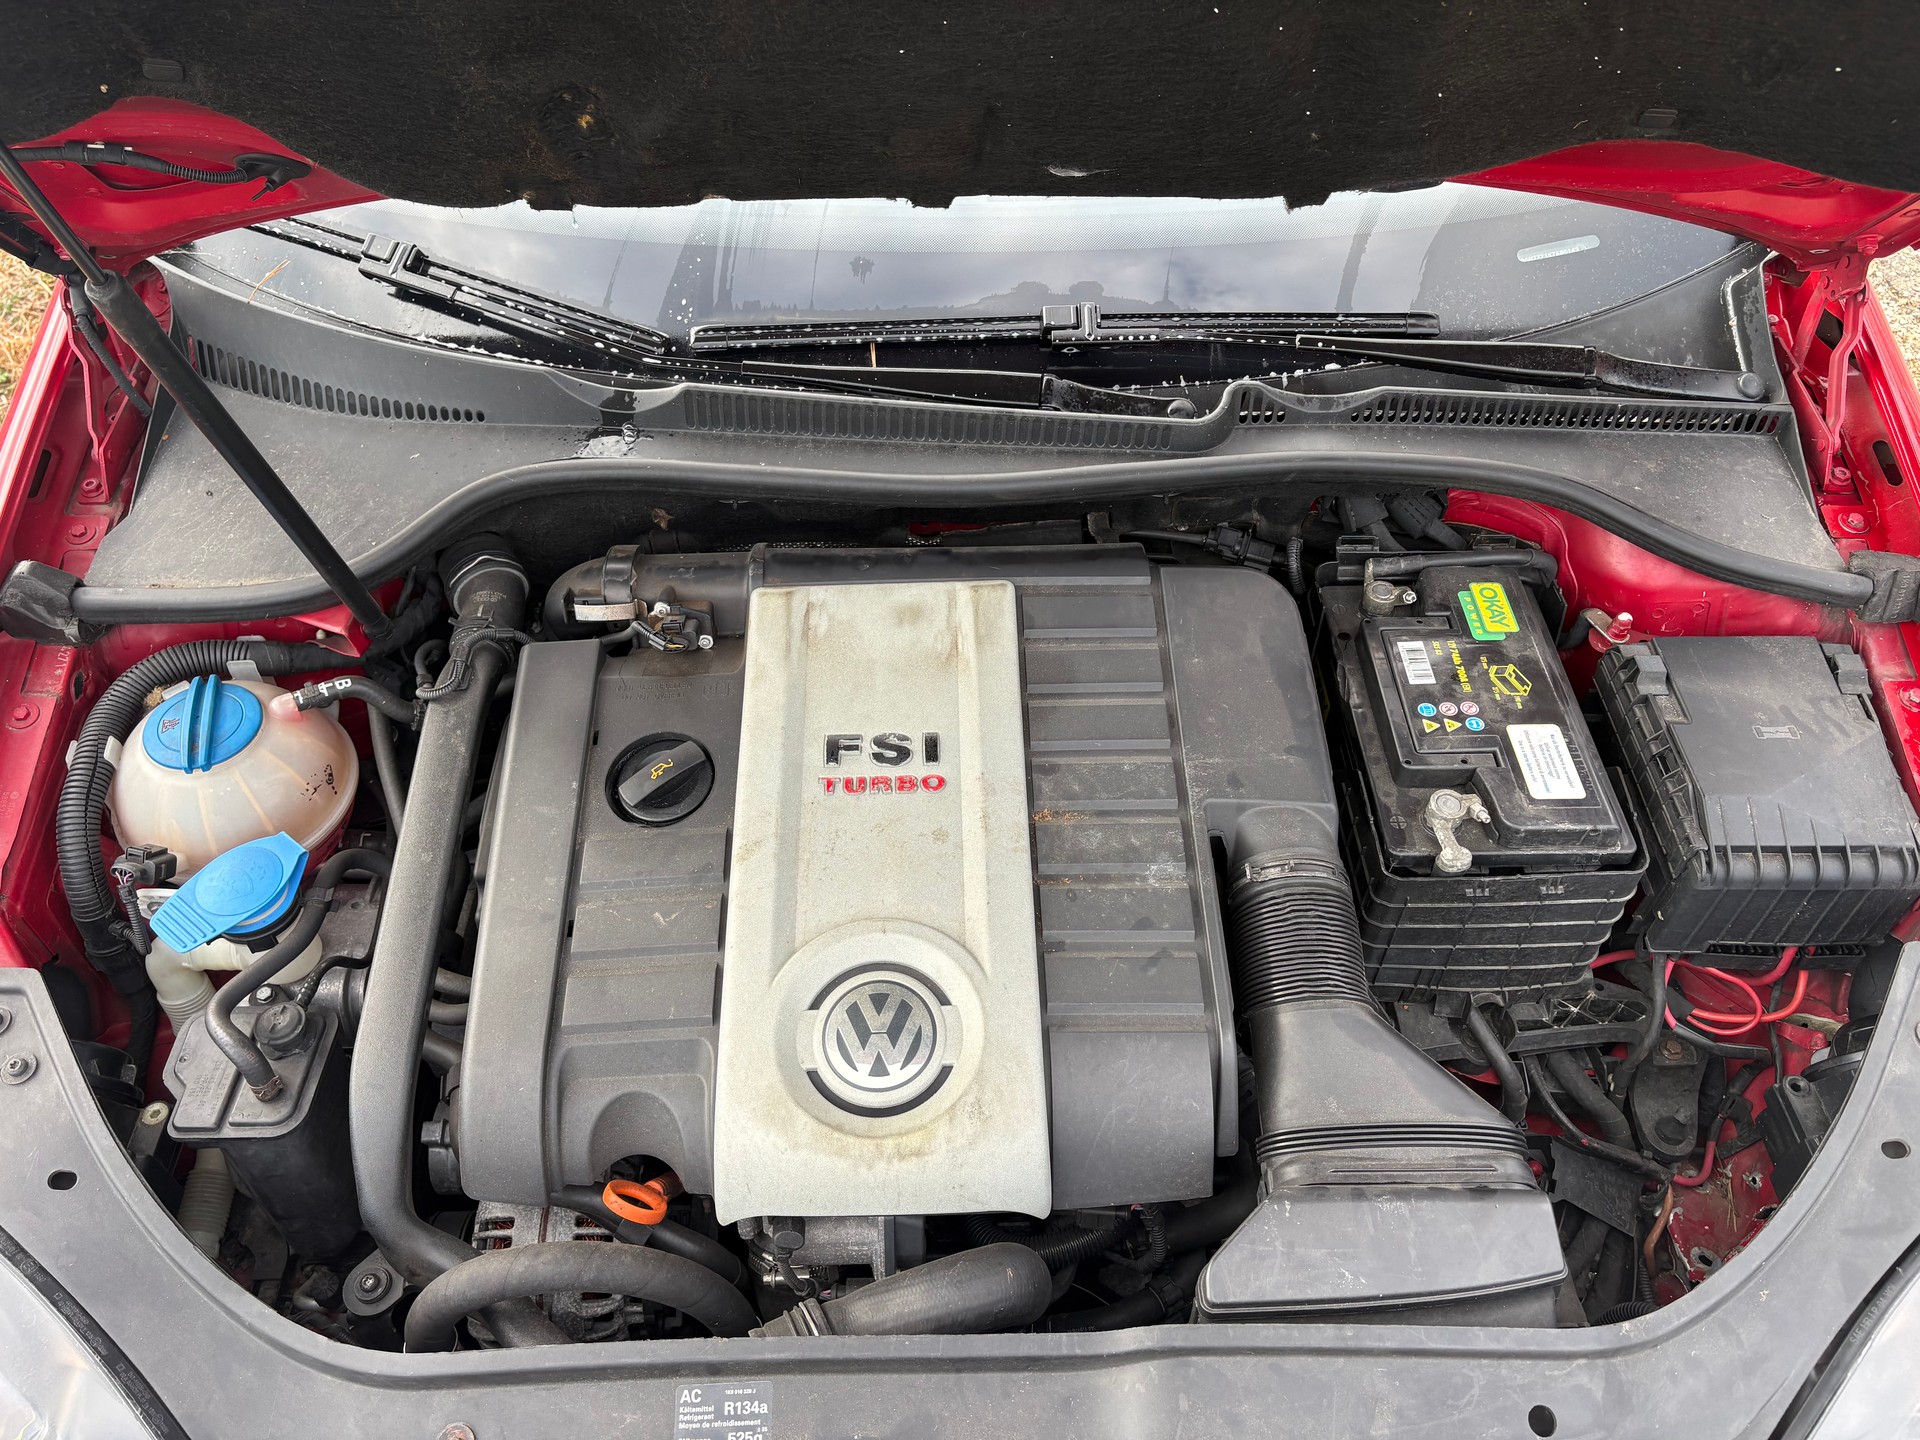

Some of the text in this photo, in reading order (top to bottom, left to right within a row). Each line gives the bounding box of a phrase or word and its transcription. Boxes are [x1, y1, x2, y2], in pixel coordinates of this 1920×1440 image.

[1463, 597, 1483, 634] POWER
[1478, 587, 1511, 628] OKAY
[1450, 647, 1462, 665] 74Ah
[1456, 665, 1469, 682] 700A
[824, 732, 941, 768] FSI
[818, 774, 947, 795] TURBO
[680, 1389, 702, 1404] AC
[679, 1414, 714, 1423] Refrigerant
[724, 1401, 768, 1415] R134a
[679, 1422, 701, 1430] Moyen
[711, 1419, 761, 1428] refroidissement
